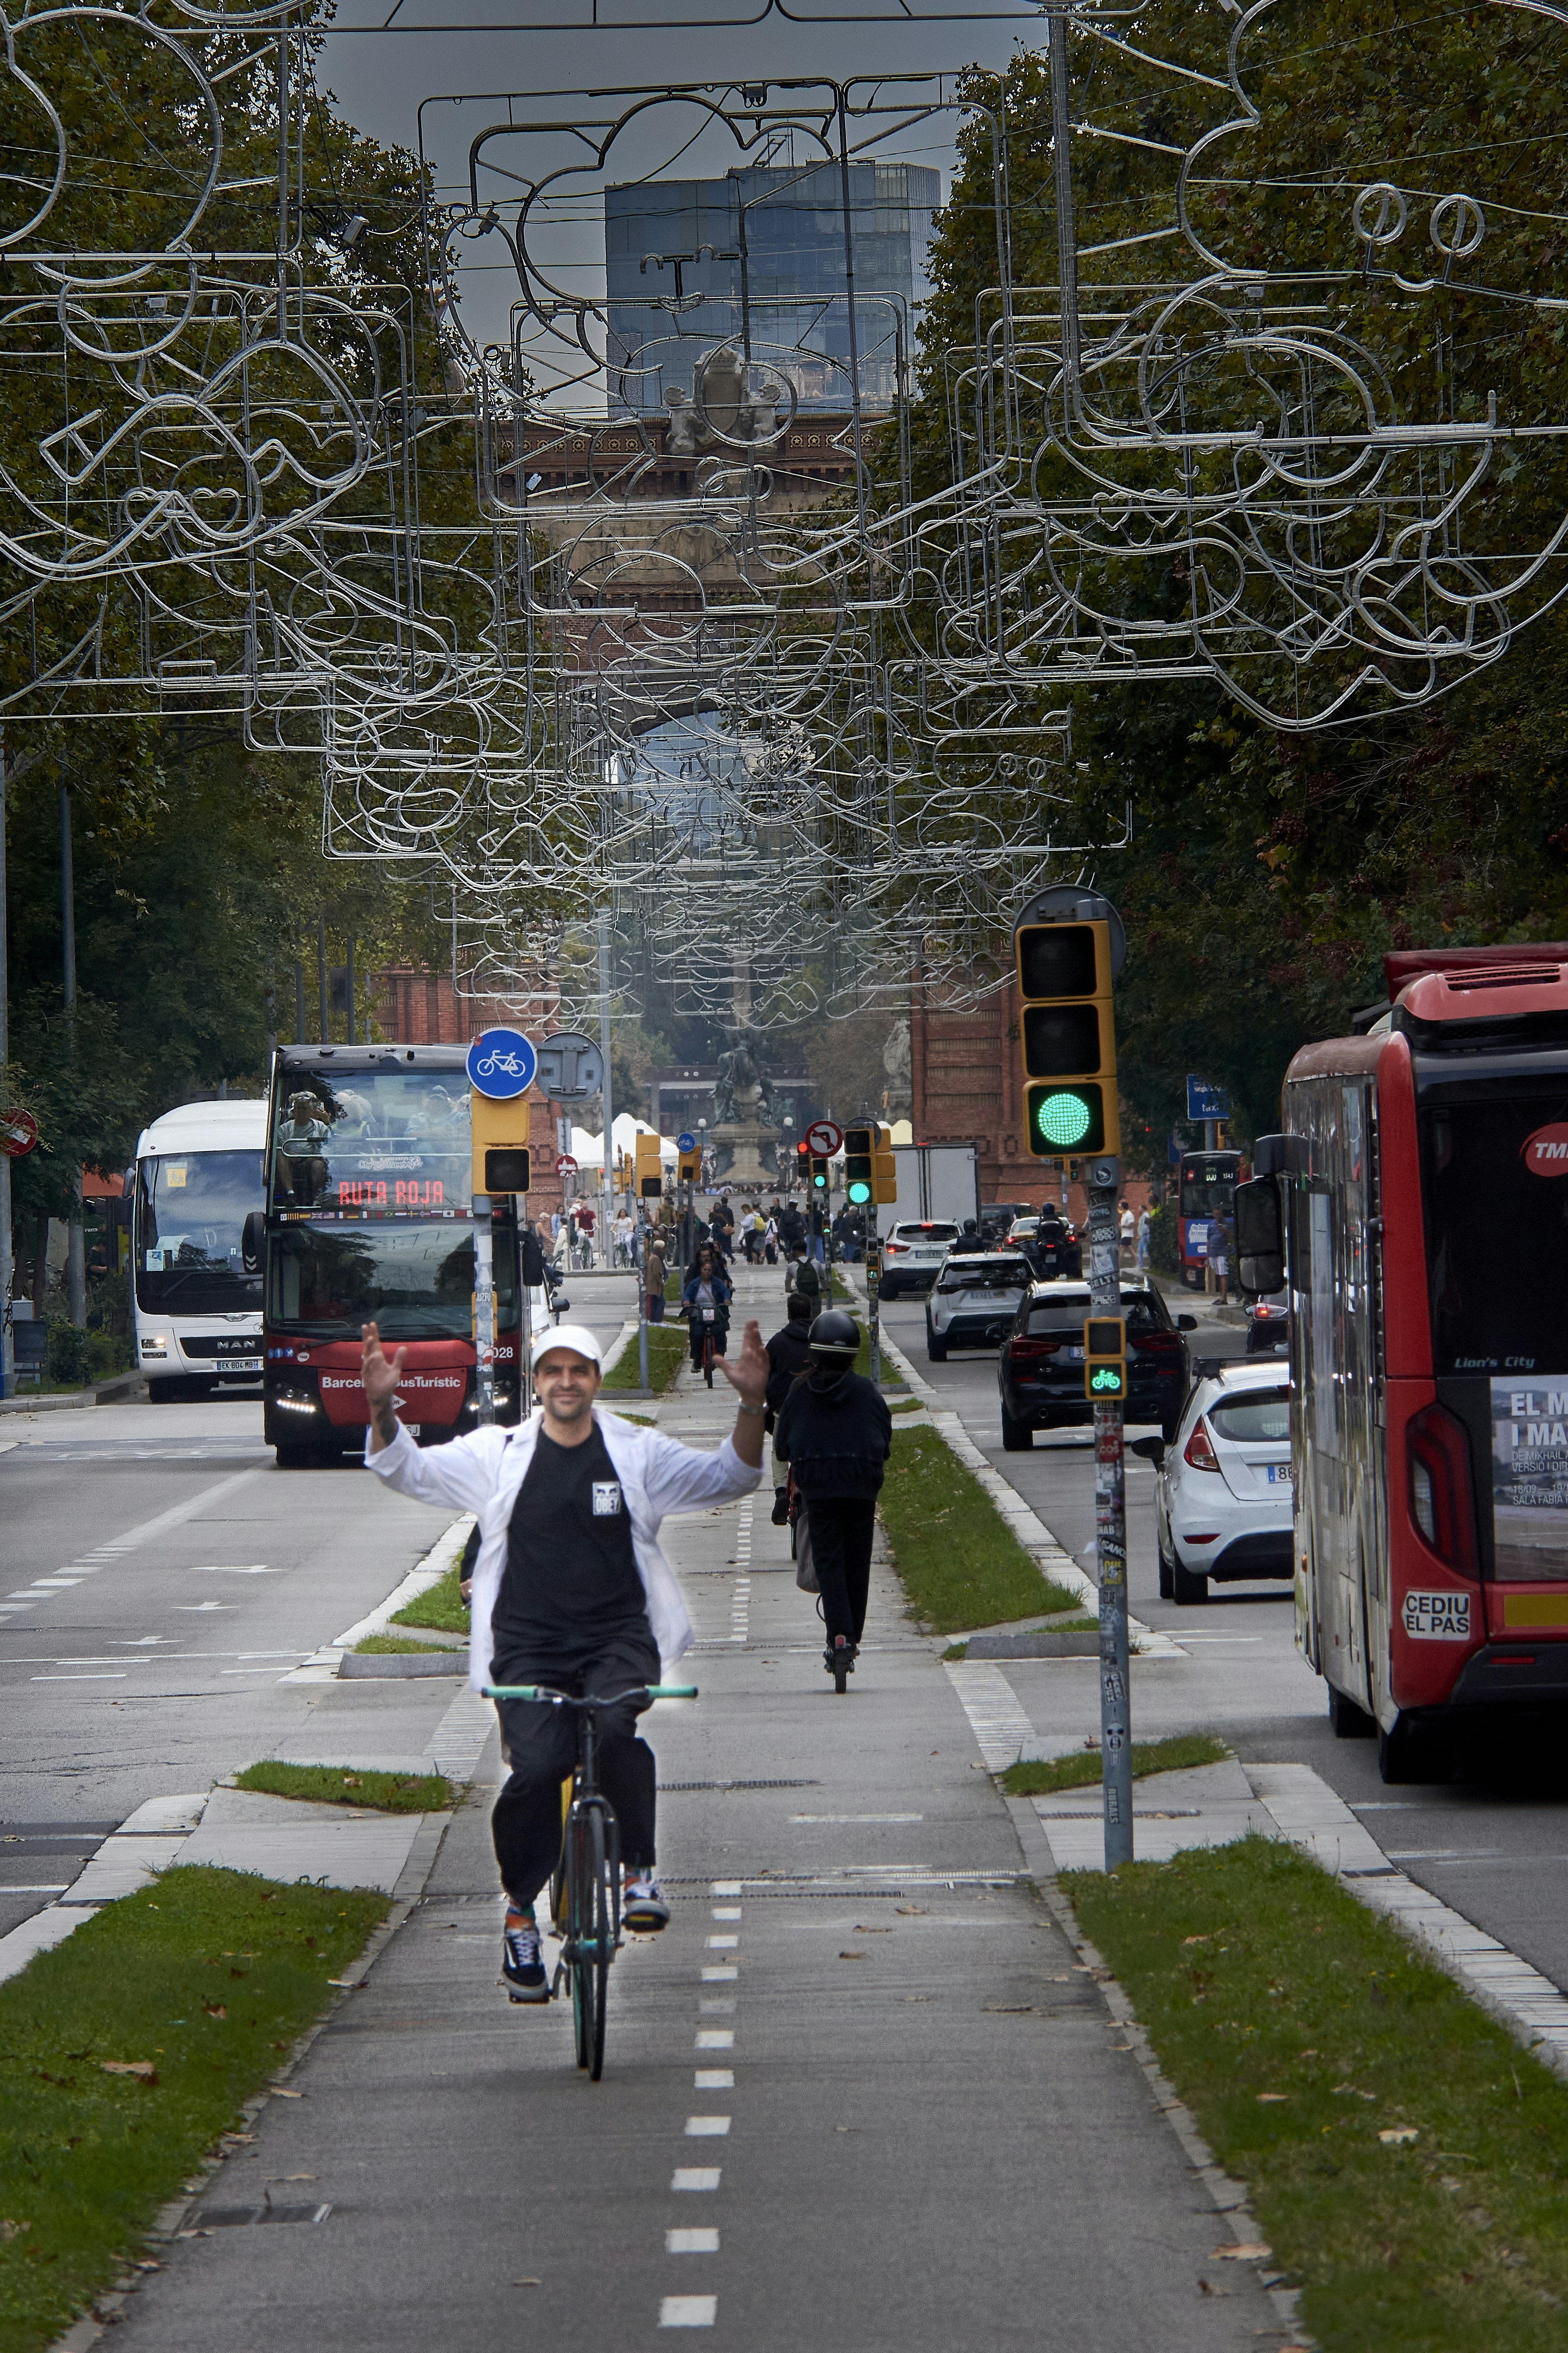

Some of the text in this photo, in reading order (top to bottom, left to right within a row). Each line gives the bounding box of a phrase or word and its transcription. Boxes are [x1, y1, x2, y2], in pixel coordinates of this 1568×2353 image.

[1536, 1143, 1568, 1158] TM
[339, 1181, 442, 1205] RUTA ROJA
[217, 1340, 256, 1350] MAN
[1455, 1356, 1535, 1369] Lion's City
[397, 1377, 461, 1388] usTurístic
[1511, 1393, 1541, 1416] EL
[1512, 1423, 1568, 1446] I MA
[1512, 1451, 1523, 1461] DE
[1527, 1450, 1563, 1461] MIKHAIL
[1514, 1485, 1537, 1493] 18/09
[1513, 1496, 1536, 1505] SALA
[1406, 1595, 1469, 1615] CEDIU
[1406, 1615, 1469, 1633] EL PAS
